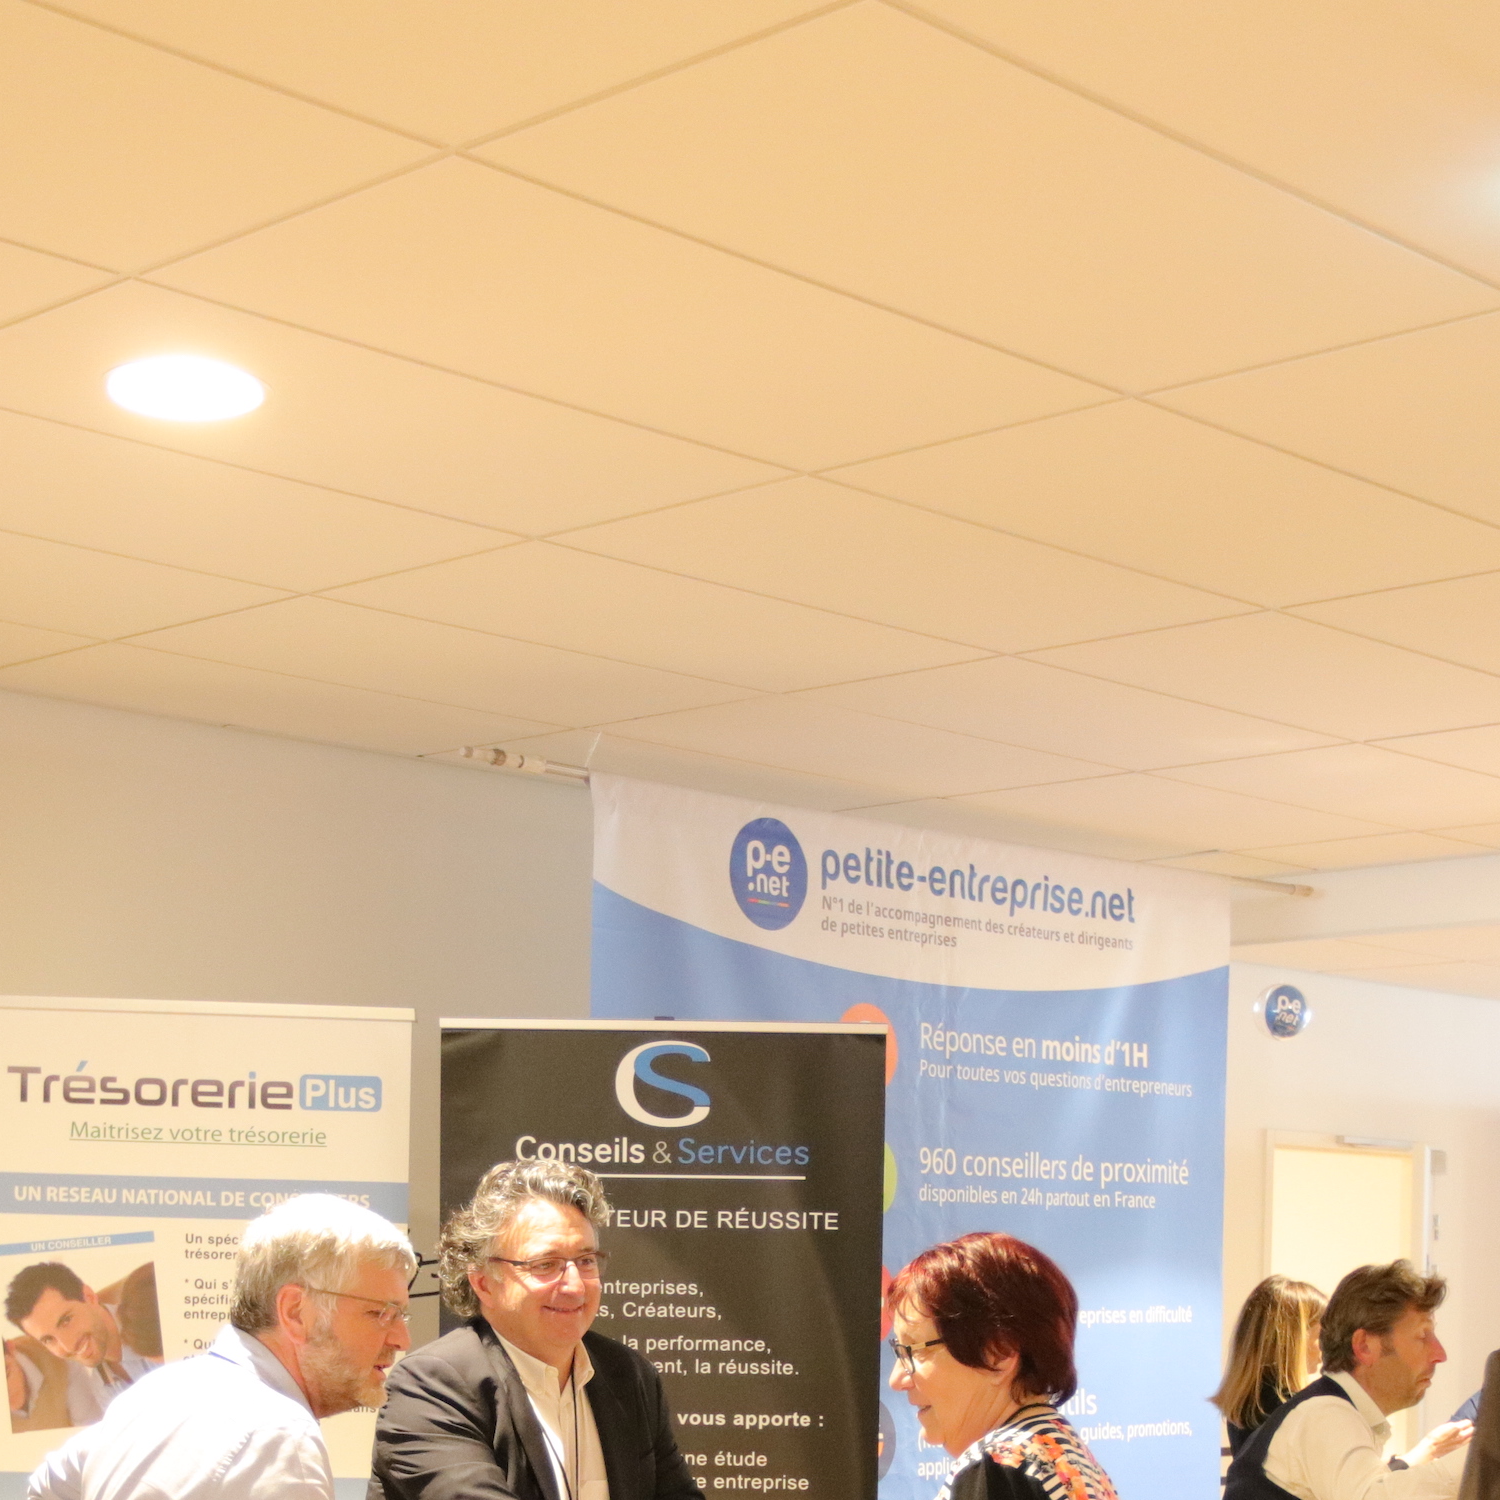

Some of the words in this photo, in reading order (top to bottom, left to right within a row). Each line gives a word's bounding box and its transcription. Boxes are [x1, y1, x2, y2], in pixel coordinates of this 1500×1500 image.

[821, 847, 1136, 923] petite-entreprise.net
[821, 916, 837, 932] de
[841, 918, 885, 939] petites
[887, 925, 957, 948] entreprises
[822, 895, 844, 913] N°1
[848, 899, 863, 916] de
[866, 902, 982, 931] l'accompagnement
[985, 918, 1005, 935] des
[1007, 923, 1061, 942] créateurs
[1063, 932, 1074, 944] et
[1078, 931, 1134, 950] dirigeants
[920, 1022, 1007, 1059] Réponse
[1012, 1036, 1037, 1059] en
[1041, 1036, 1100, 1064] moins
[7, 1060, 294, 1111] Trésorerie
[304, 1078, 377, 1110] Plus
[919, 1059, 953, 1079] Pour
[956, 1064, 1000, 1083] toutes
[1003, 1070, 1026, 1085] vos
[1030, 1071, 1091, 1091] questions
[1094, 1073, 1192, 1098] d'entrepreneurs
[70, 1121, 164, 1141] Maitrisez
[169, 1126, 222, 1143] votre
[228, 1126, 327, 1145] trésorerie
[515, 1135, 645, 1163] Conseils
[652, 1141, 672, 1164] &
[678, 1137, 810, 1165] Services
[919, 1147, 957, 1175] 960
[962, 1151, 1067, 1180] conseillers
[1071, 1154, 1094, 1181] de
[1101, 1158, 1189, 1189] proximité
[14, 1185, 42, 1202] UN
[46, 1186, 118, 1204] RESEAU
[122, 1188, 216, 1207] NATIONAL
[221, 1190, 245, 1207] DE
[918, 1183, 998, 1207] disponibles
[1001, 1190, 1017, 1204] en
[1020, 1187, 1042, 1206] 24h
[1045, 1190, 1090, 1210] partout
[1093, 1194, 1110, 1208] en
[1114, 1191, 1156, 1209] France
[604, 1209, 667, 1228] TEUR
[675, 1210, 708, 1229] DE
[717, 1207, 839, 1231] RÉUSSITE
[30, 1242, 46, 1252] UN
[48, 1236, 112, 1250] CONSEILLER
[185, 1233, 203, 1244] Un
[208, 1234, 239, 1247] spéc
[185, 1248, 238, 1260] trésorer
[184, 1294, 231, 1307] spécifi
[622, 1302, 722, 1321] Créateurs,
[183, 1309, 231, 1322] entrepr
[1079, 1307, 1127, 1328] eprises
[1129, 1309, 1143, 1324] en
[1145, 1305, 1192, 1323] difficulté
[645, 1335, 771, 1354] performance,
[695, 1359, 711, 1374] la
[718, 1359, 799, 1376] réussite.
[677, 1413, 726, 1426] vous
[733, 1412, 811, 1430] apporte
[1080, 1422, 1124, 1444] guides,
[1127, 1419, 1193, 1442] promotions,
[714, 1451, 768, 1467] étude
[713, 1475, 810, 1493] entreprise
